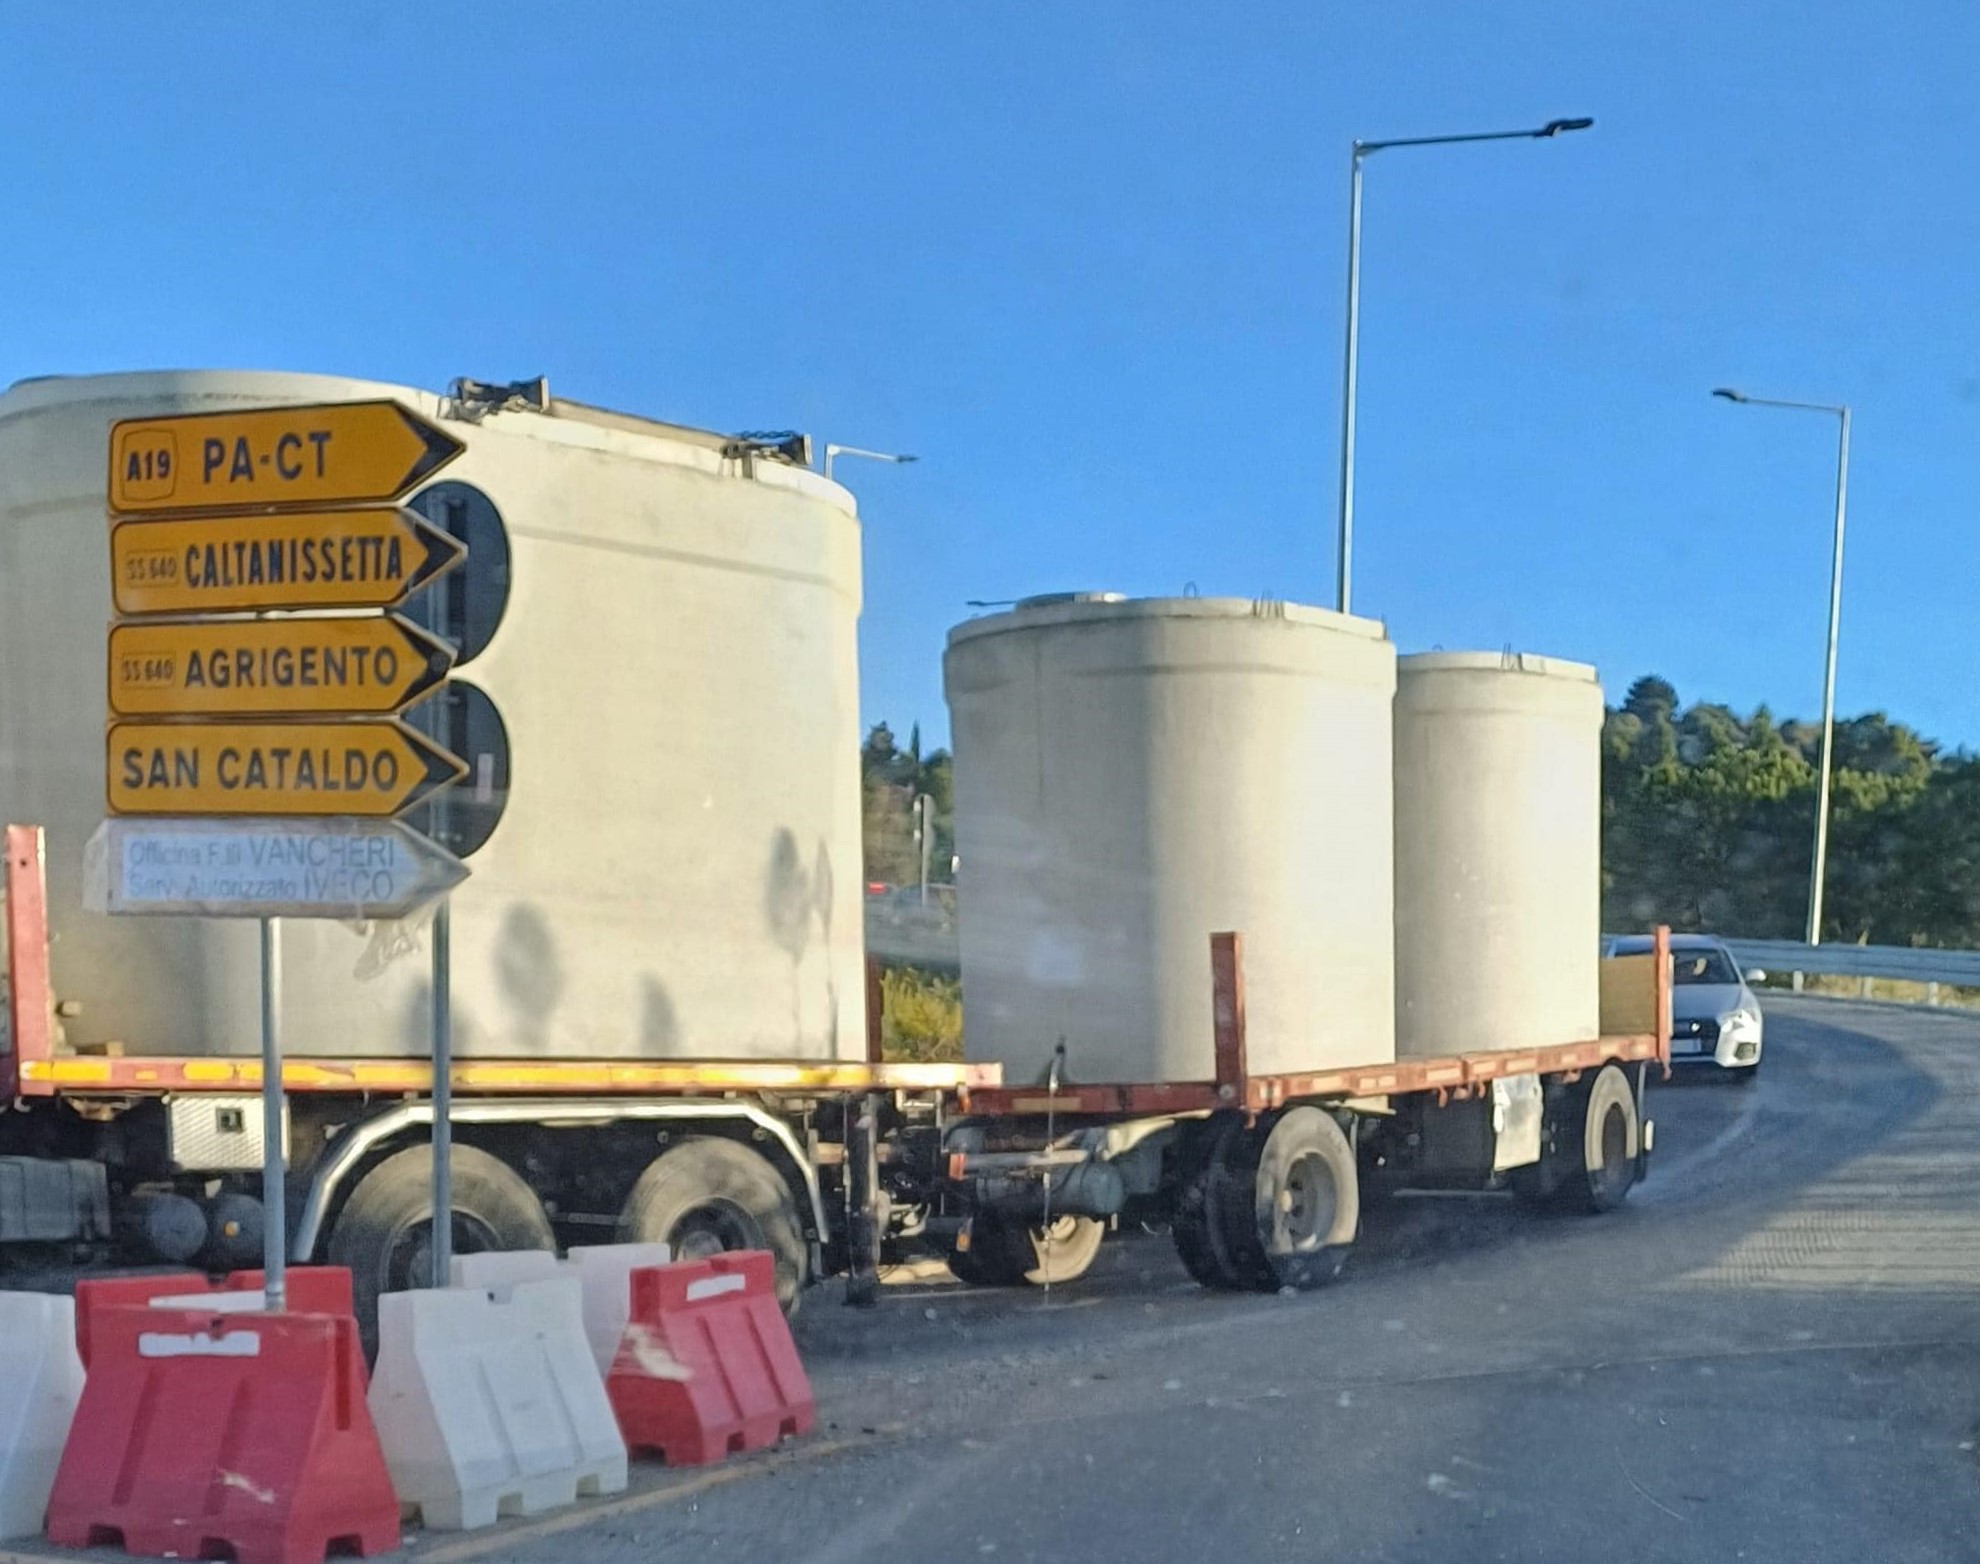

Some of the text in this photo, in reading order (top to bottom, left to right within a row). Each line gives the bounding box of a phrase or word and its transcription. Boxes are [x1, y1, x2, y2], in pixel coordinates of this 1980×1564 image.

[126, 449, 171, 481] A19
[203, 432, 332, 484] PA-CT
[185, 535, 403, 588] CALTANISSETTA
[145, 660, 174, 681] 640
[184, 646, 398, 688] AGRIGENTO
[122, 748, 398, 791] SAN CATALDO
[248, 836, 394, 867] VANCHERI
[304, 870, 394, 900] IVECO
